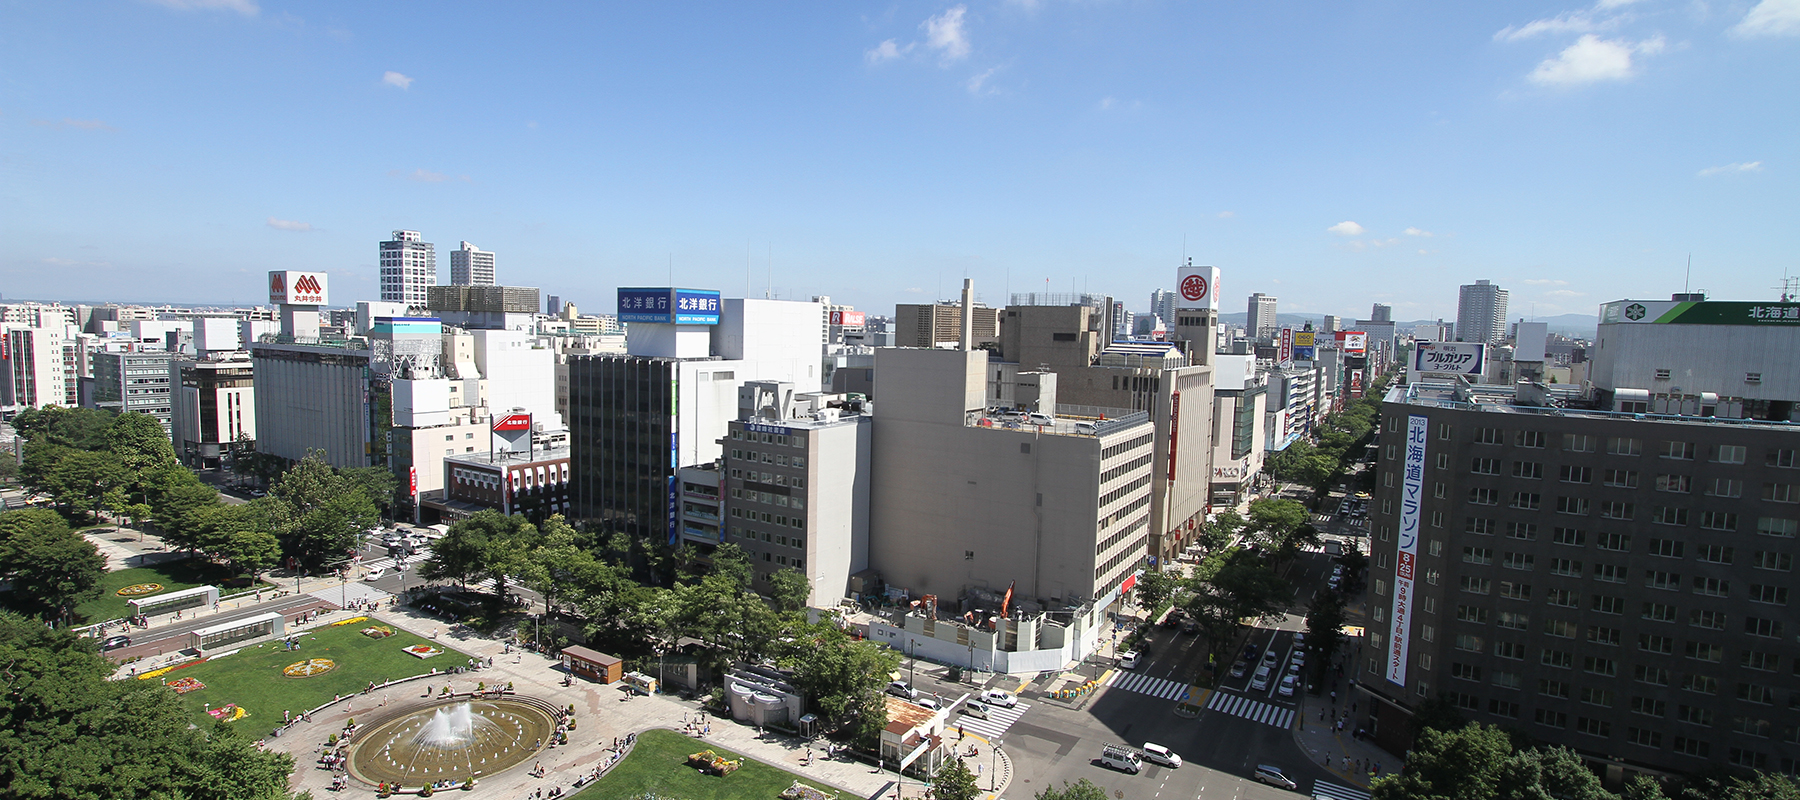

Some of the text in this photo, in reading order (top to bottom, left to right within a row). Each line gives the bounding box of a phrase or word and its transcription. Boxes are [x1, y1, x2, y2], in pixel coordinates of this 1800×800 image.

[622, 297, 667, 309] 北洋銀行
[679, 297, 717, 311] 北洋銀行
[1427, 351, 1473, 364] ブルガリア
[1434, 363, 1462, 371] ヨーグルト
[1410, 417, 1426, 426] 2013
[1401, 426, 1424, 549] 北海道マラソン
